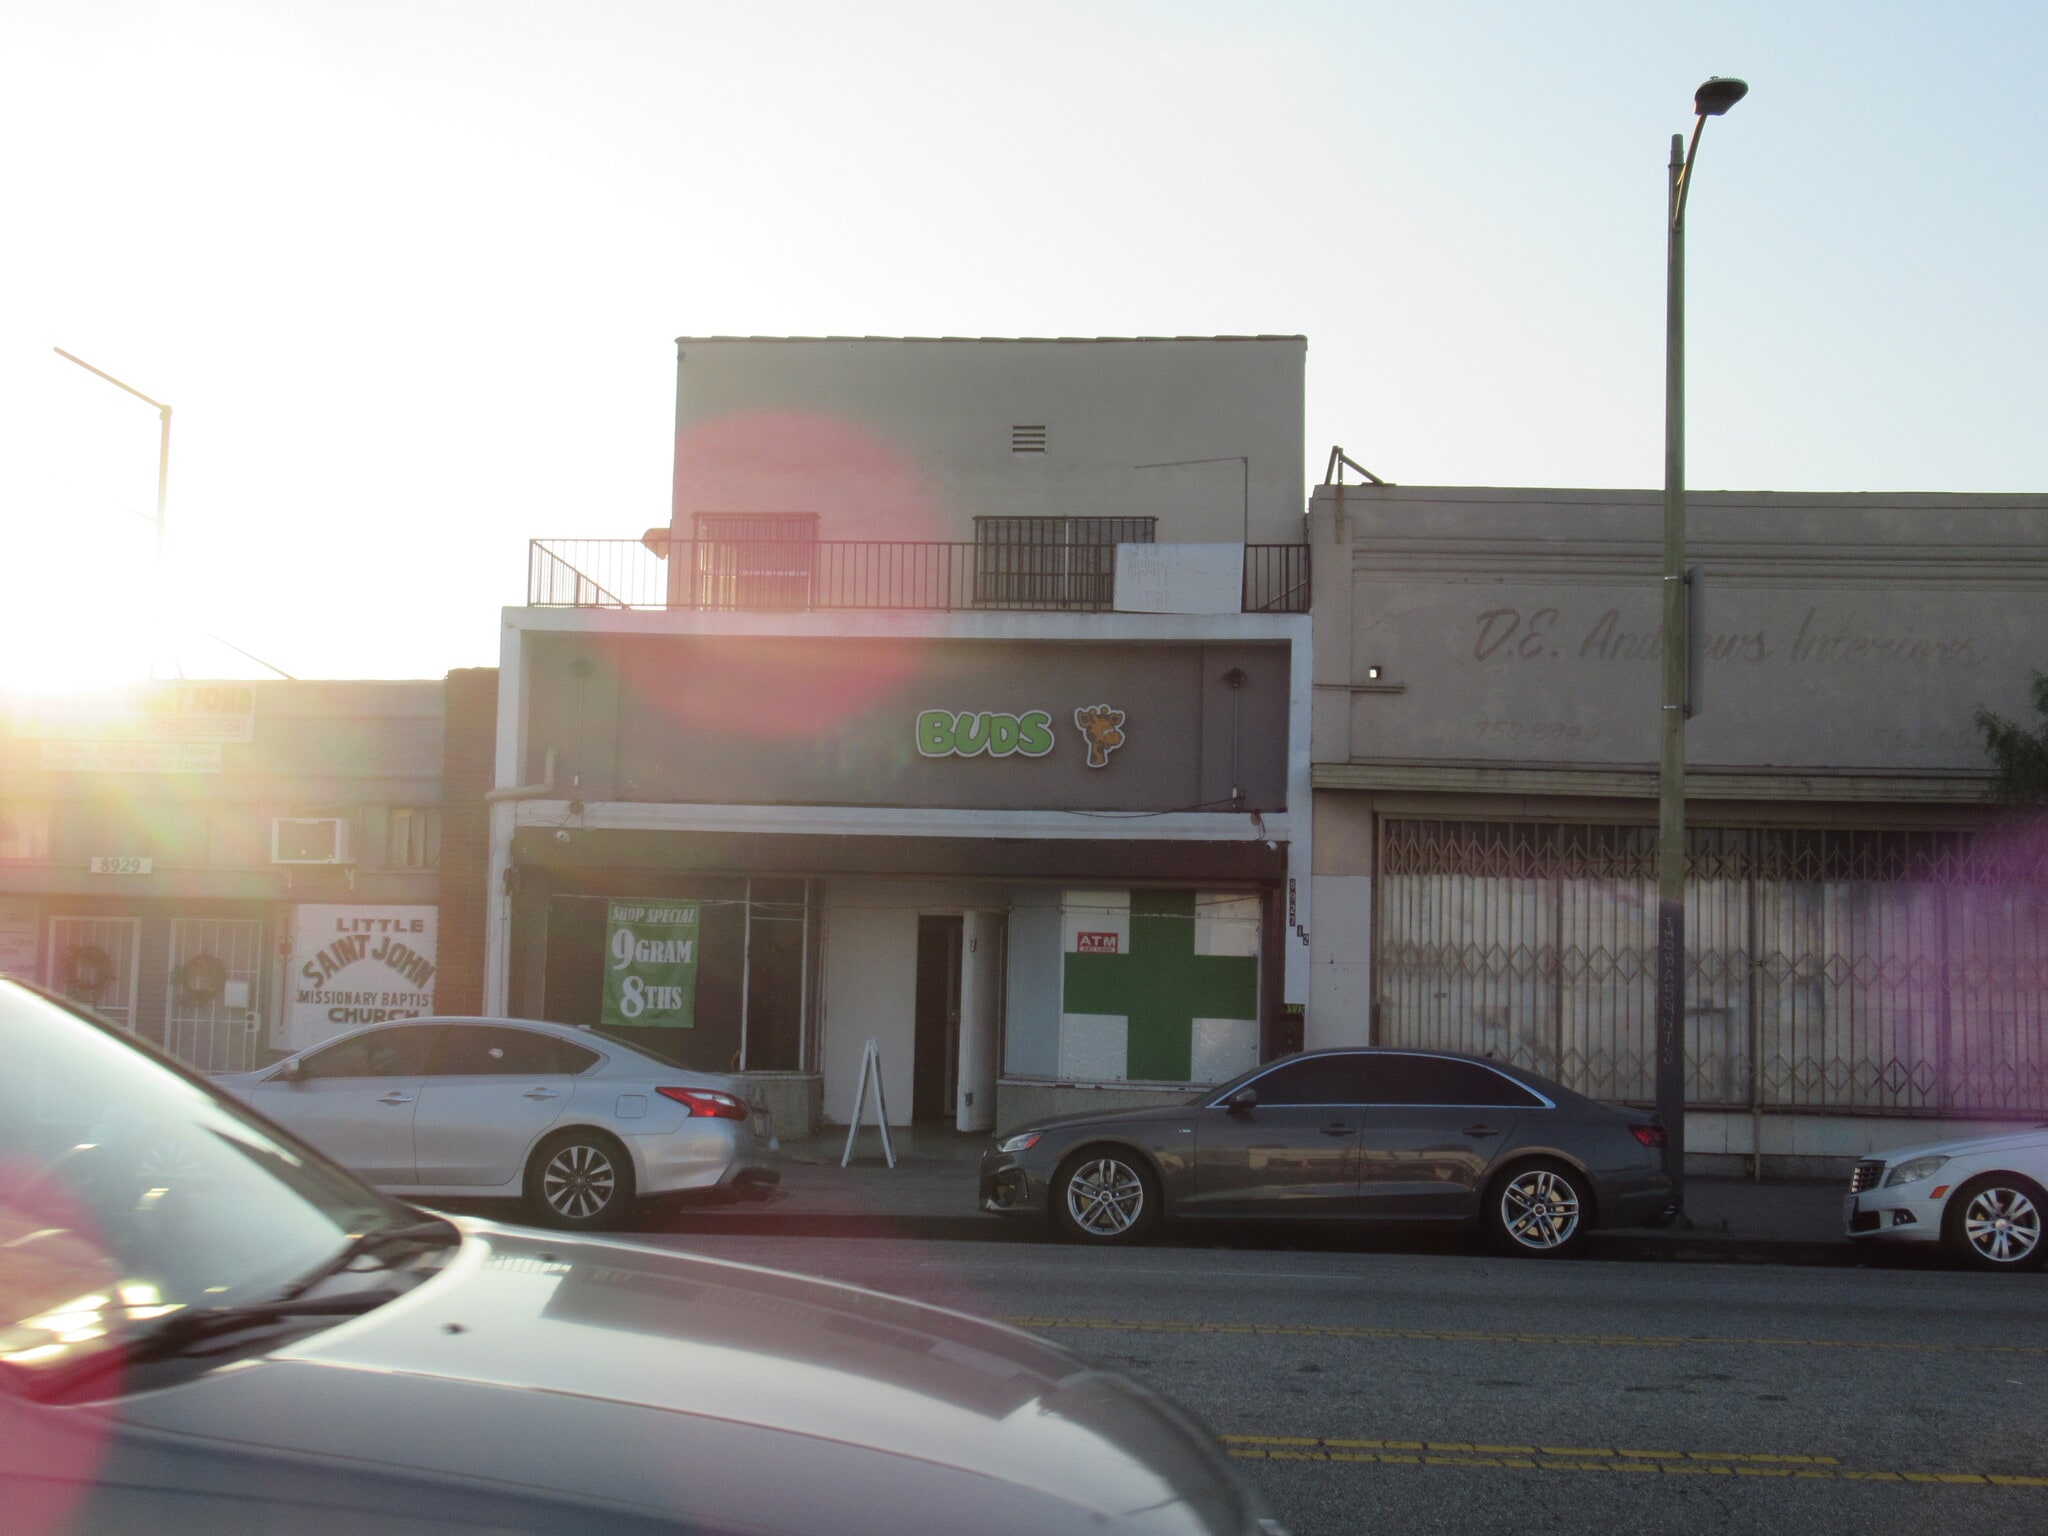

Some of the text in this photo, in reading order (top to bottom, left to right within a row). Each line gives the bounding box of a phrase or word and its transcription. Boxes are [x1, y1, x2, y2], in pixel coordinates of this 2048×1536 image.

[1473, 607, 1560, 662] D.E.
[1580, 607, 1774, 663] Andews
[916, 709, 1054, 757] BUDS
[100, 858, 141, 873] 8929
[612, 906, 696, 924] SHOP SPECIAL
[336, 918, 424, 933] LITTLE
[1080, 935, 1116, 946] ATM
[302, 935, 436, 989] SAINT JOHN
[298, 990, 434, 1006] MISSIONARY BAPTIS
